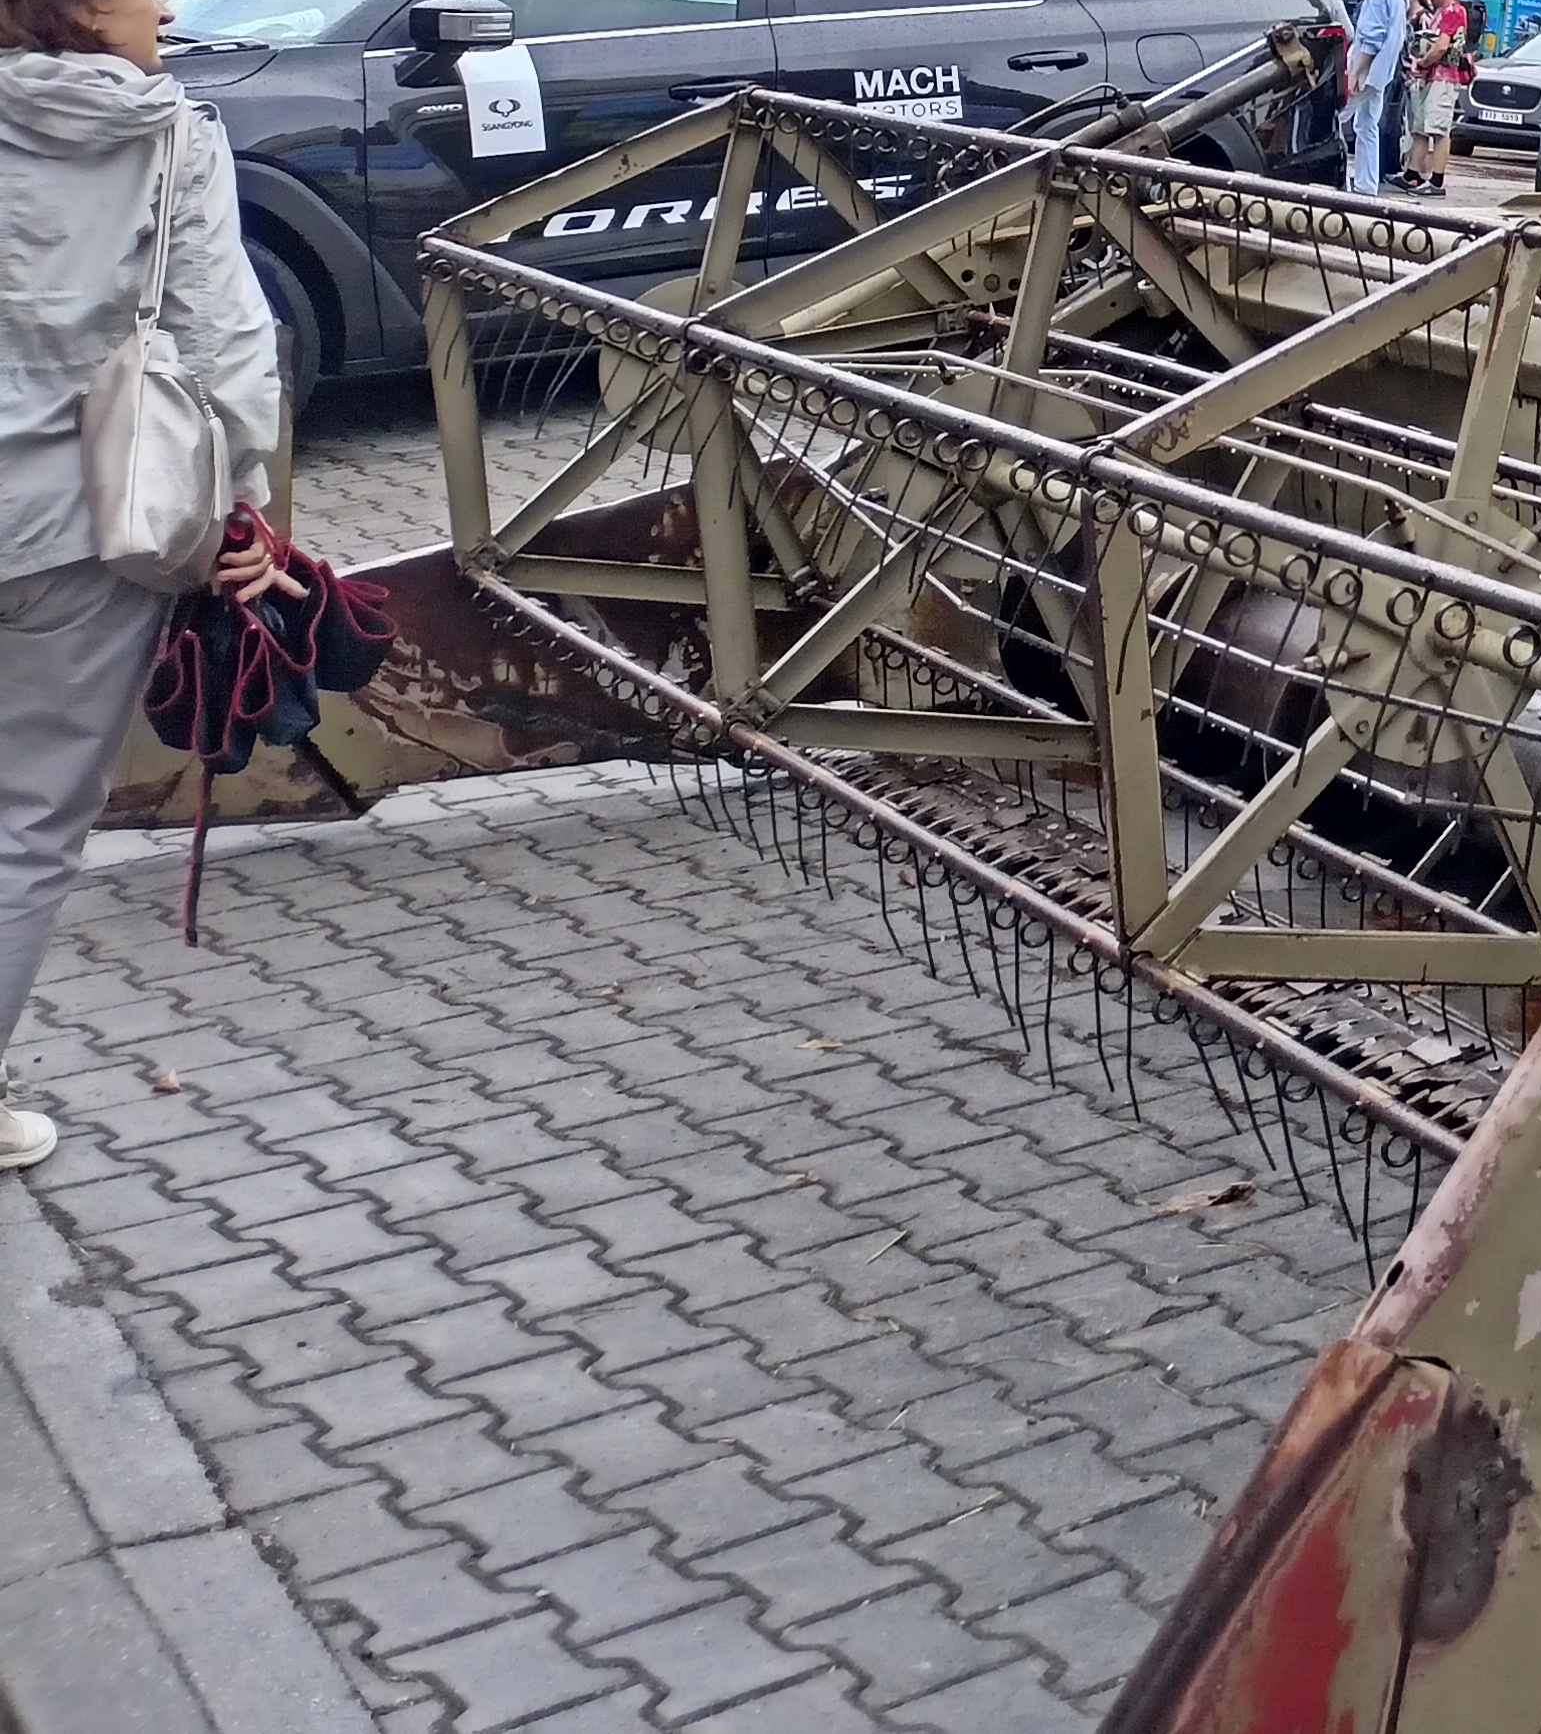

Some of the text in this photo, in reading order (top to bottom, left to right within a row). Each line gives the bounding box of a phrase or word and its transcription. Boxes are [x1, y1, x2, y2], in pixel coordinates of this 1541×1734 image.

[854, 65, 961, 99] MACH
[416, 103, 464, 114] AWD
[862, 100, 958, 117] OTORS
[481, 120, 534, 132] SSANGYONG
[488, 174, 912, 244] ORRES
